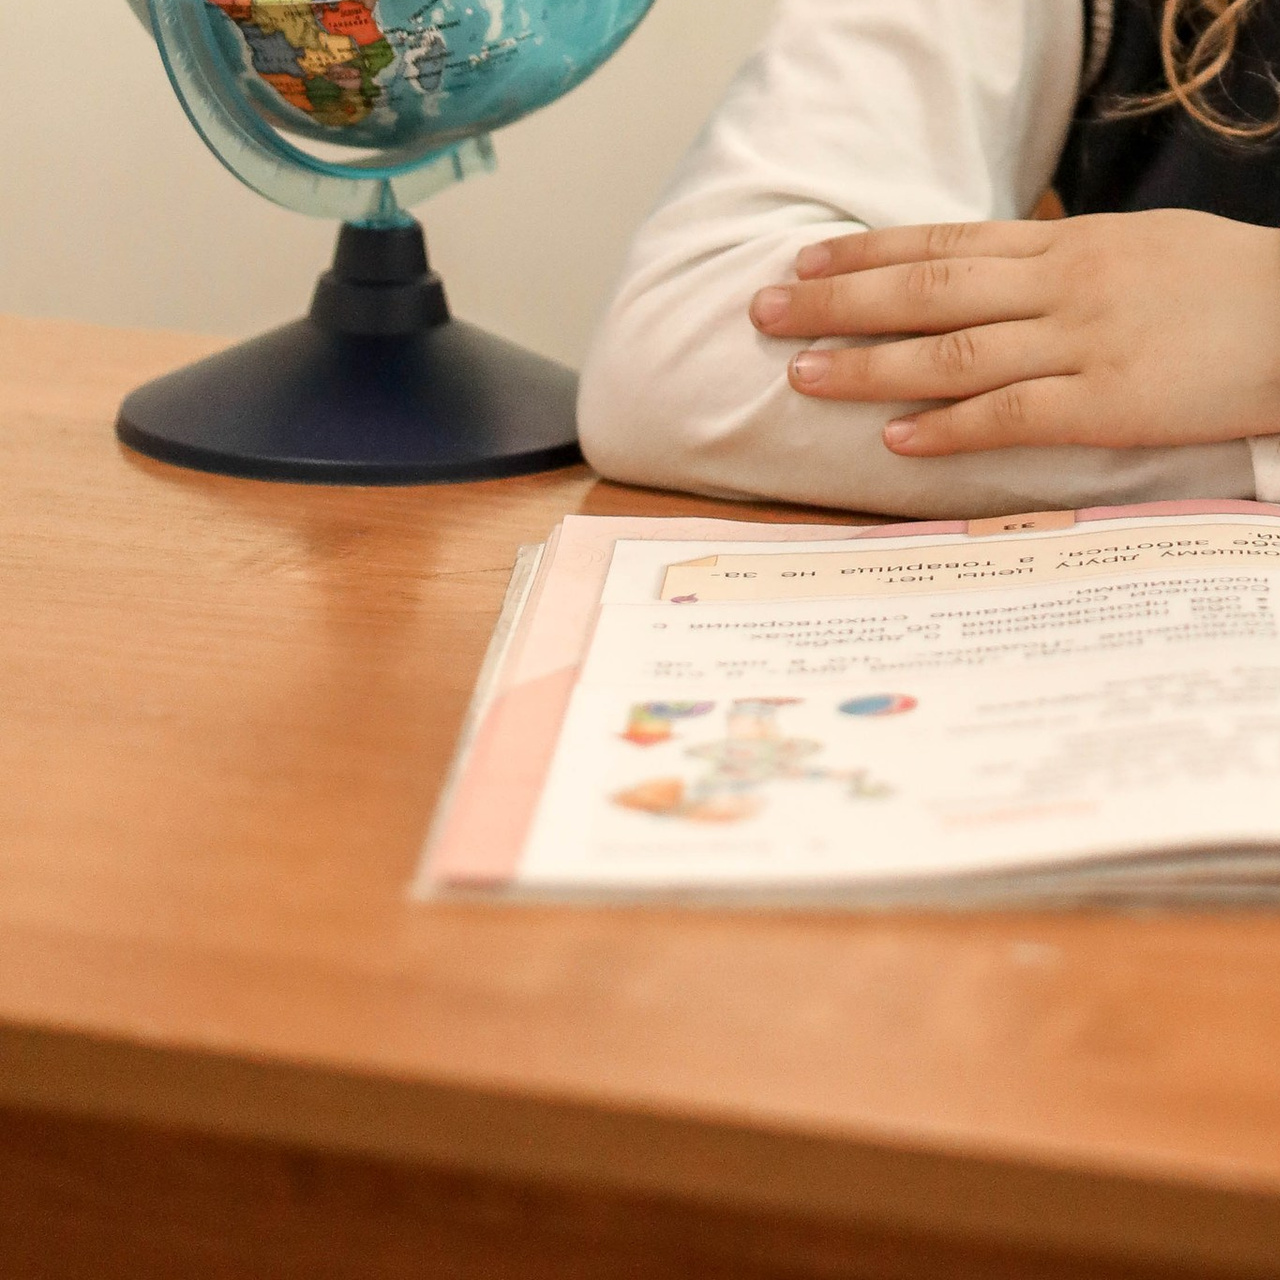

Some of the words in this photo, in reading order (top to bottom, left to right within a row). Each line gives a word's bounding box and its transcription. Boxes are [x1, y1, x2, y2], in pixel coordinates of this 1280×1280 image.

[840, 560, 996, 575] товарища
[1055, 553, 1141, 570] другу
[710, 571, 758, 579] за-
[876, 575, 935, 584] нет.
[957, 567, 1035, 580] цены
